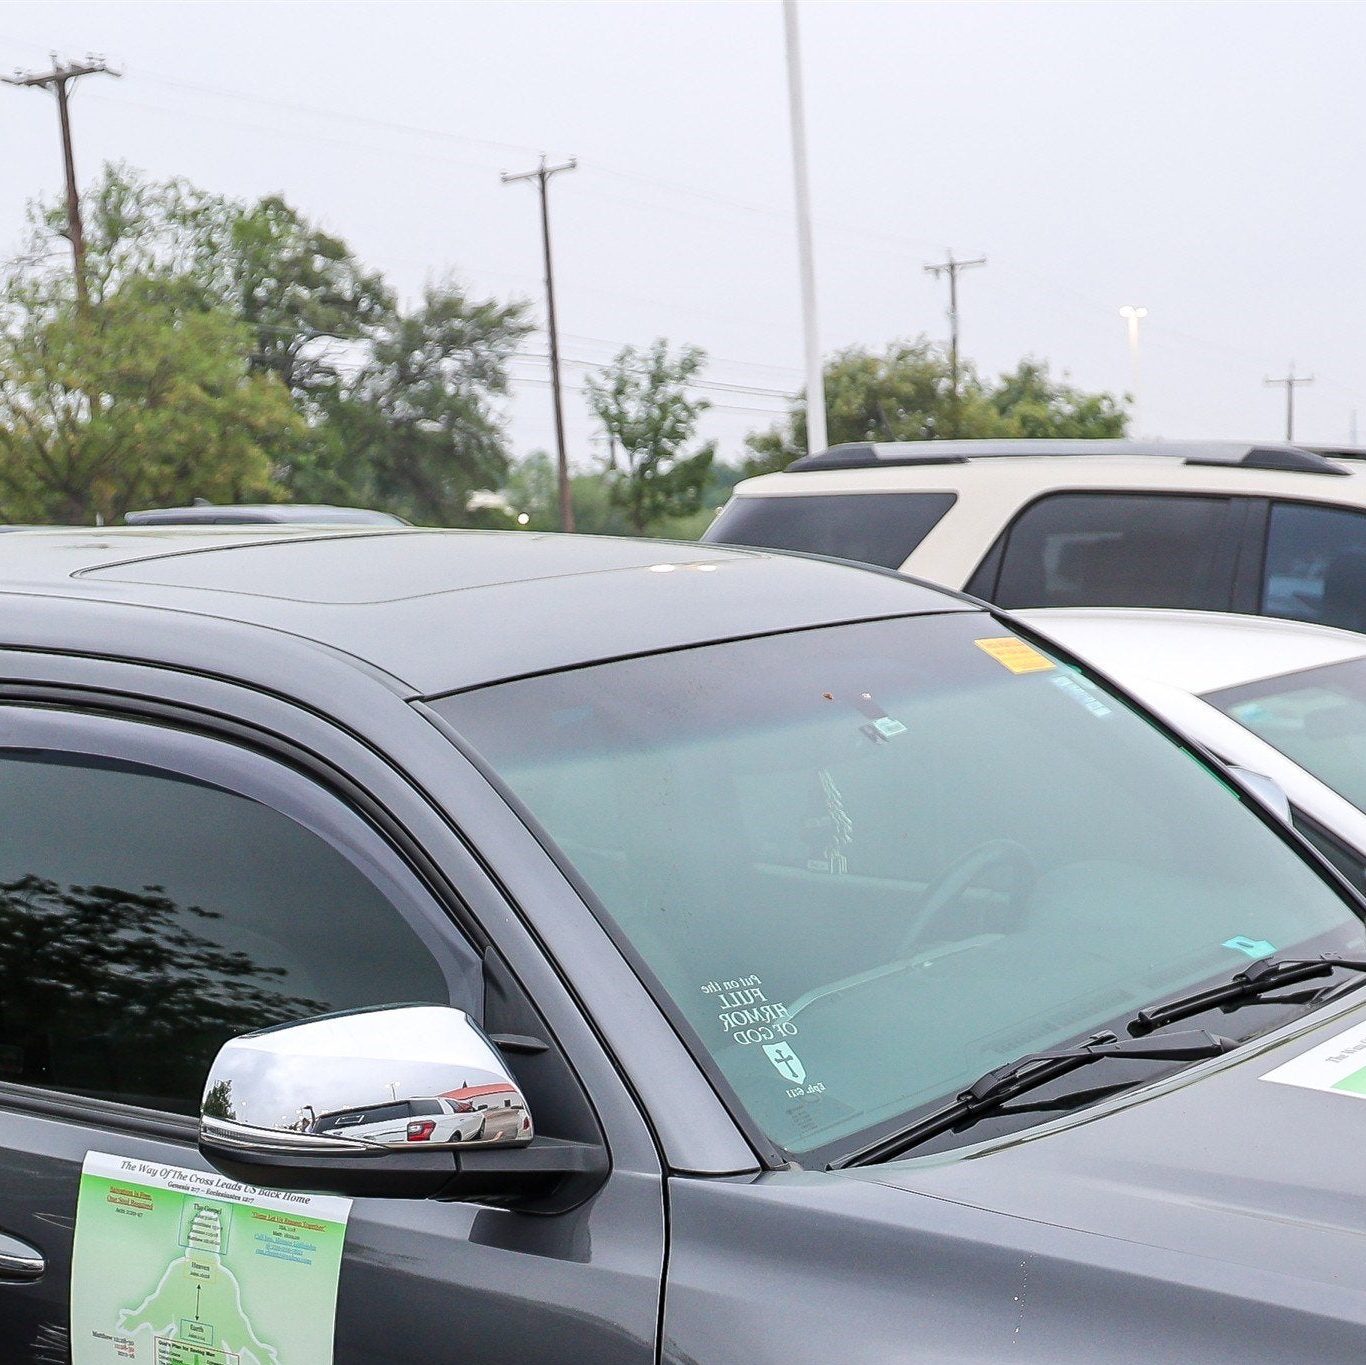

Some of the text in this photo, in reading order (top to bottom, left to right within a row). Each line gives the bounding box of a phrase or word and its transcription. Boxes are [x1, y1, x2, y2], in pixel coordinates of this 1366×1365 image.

[120, 1160, 311, 1205] The Way Of The Cross Leads US Back Home
[167, 1180, 189, 1191] Genesis
[190, 1186, 200, 1194] 2:7
[205, 1188, 240, 1200] Ecclesiastes
